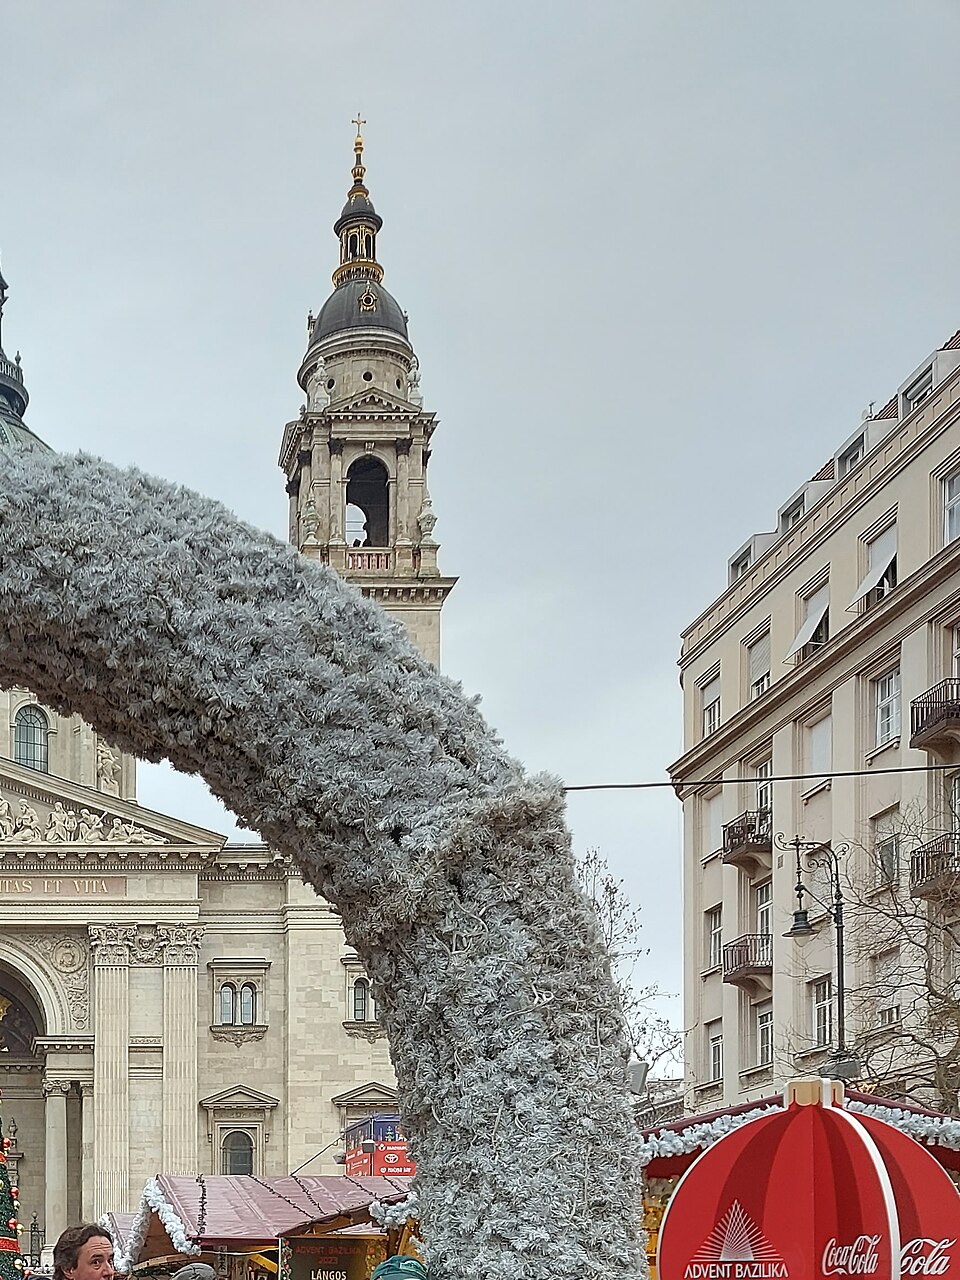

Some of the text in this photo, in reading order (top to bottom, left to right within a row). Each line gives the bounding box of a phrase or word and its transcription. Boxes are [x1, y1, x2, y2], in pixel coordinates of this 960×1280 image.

[43, 879, 63, 893] ET
[72, 879, 109, 893] VITA
[311, 1268, 347, 1280] LÁNGOS
[684, 1263, 789, 1279] ADVENT BAZILIKA
